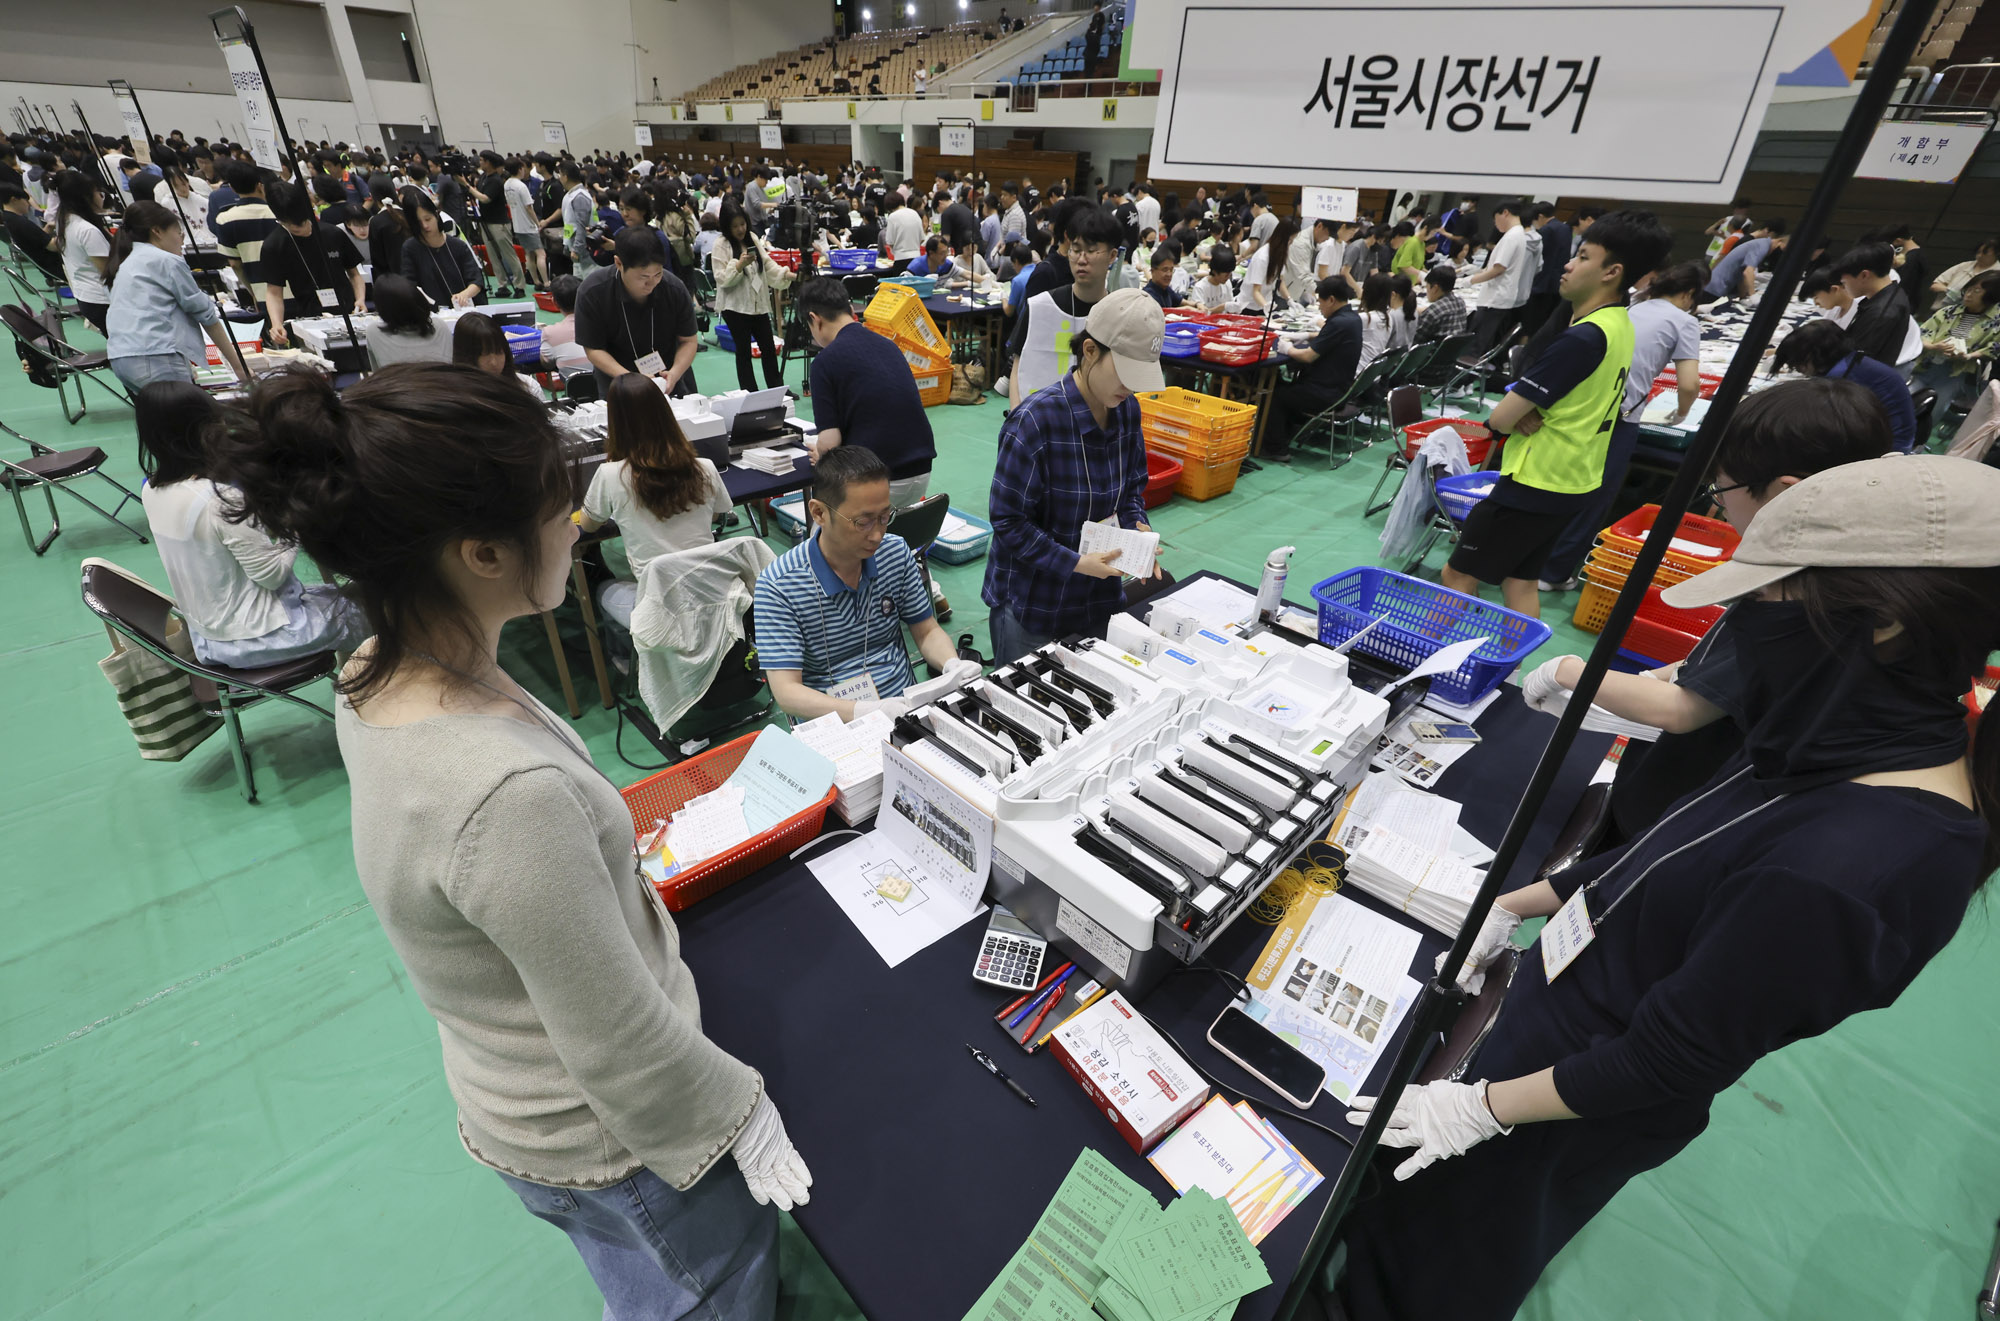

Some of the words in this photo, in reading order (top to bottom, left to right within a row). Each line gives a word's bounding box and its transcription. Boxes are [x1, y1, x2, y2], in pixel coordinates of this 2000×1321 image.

[1303, 54, 1601, 134] 서울시장선거
[1104, 104, 1115, 119] M
[1890, 152, 1940, 166] (제4반)
[834, 680, 868, 698] 개표사무원
[1074, 817, 1085, 826] 12
[860, 862, 871, 870] 314
[907, 866, 918, 874] 317
[916, 875, 928, 884] 318
[862, 889, 874, 898] 315
[872, 900, 884, 908] 316
[1567, 902, 1582, 947] 개표사무원
[1256, 927, 1294, 982] 투표지분류기운영부
[1081, 1054, 1109, 1083] 여유분
[1108, 1085, 1130, 1107] 없음
[1089, 1048, 1110, 1068] 장갑
[1109, 1069, 1139, 1100] 소진시
[1192, 1130, 1214, 1153] 투표지
[1211, 1151, 1235, 1175] 받침대
